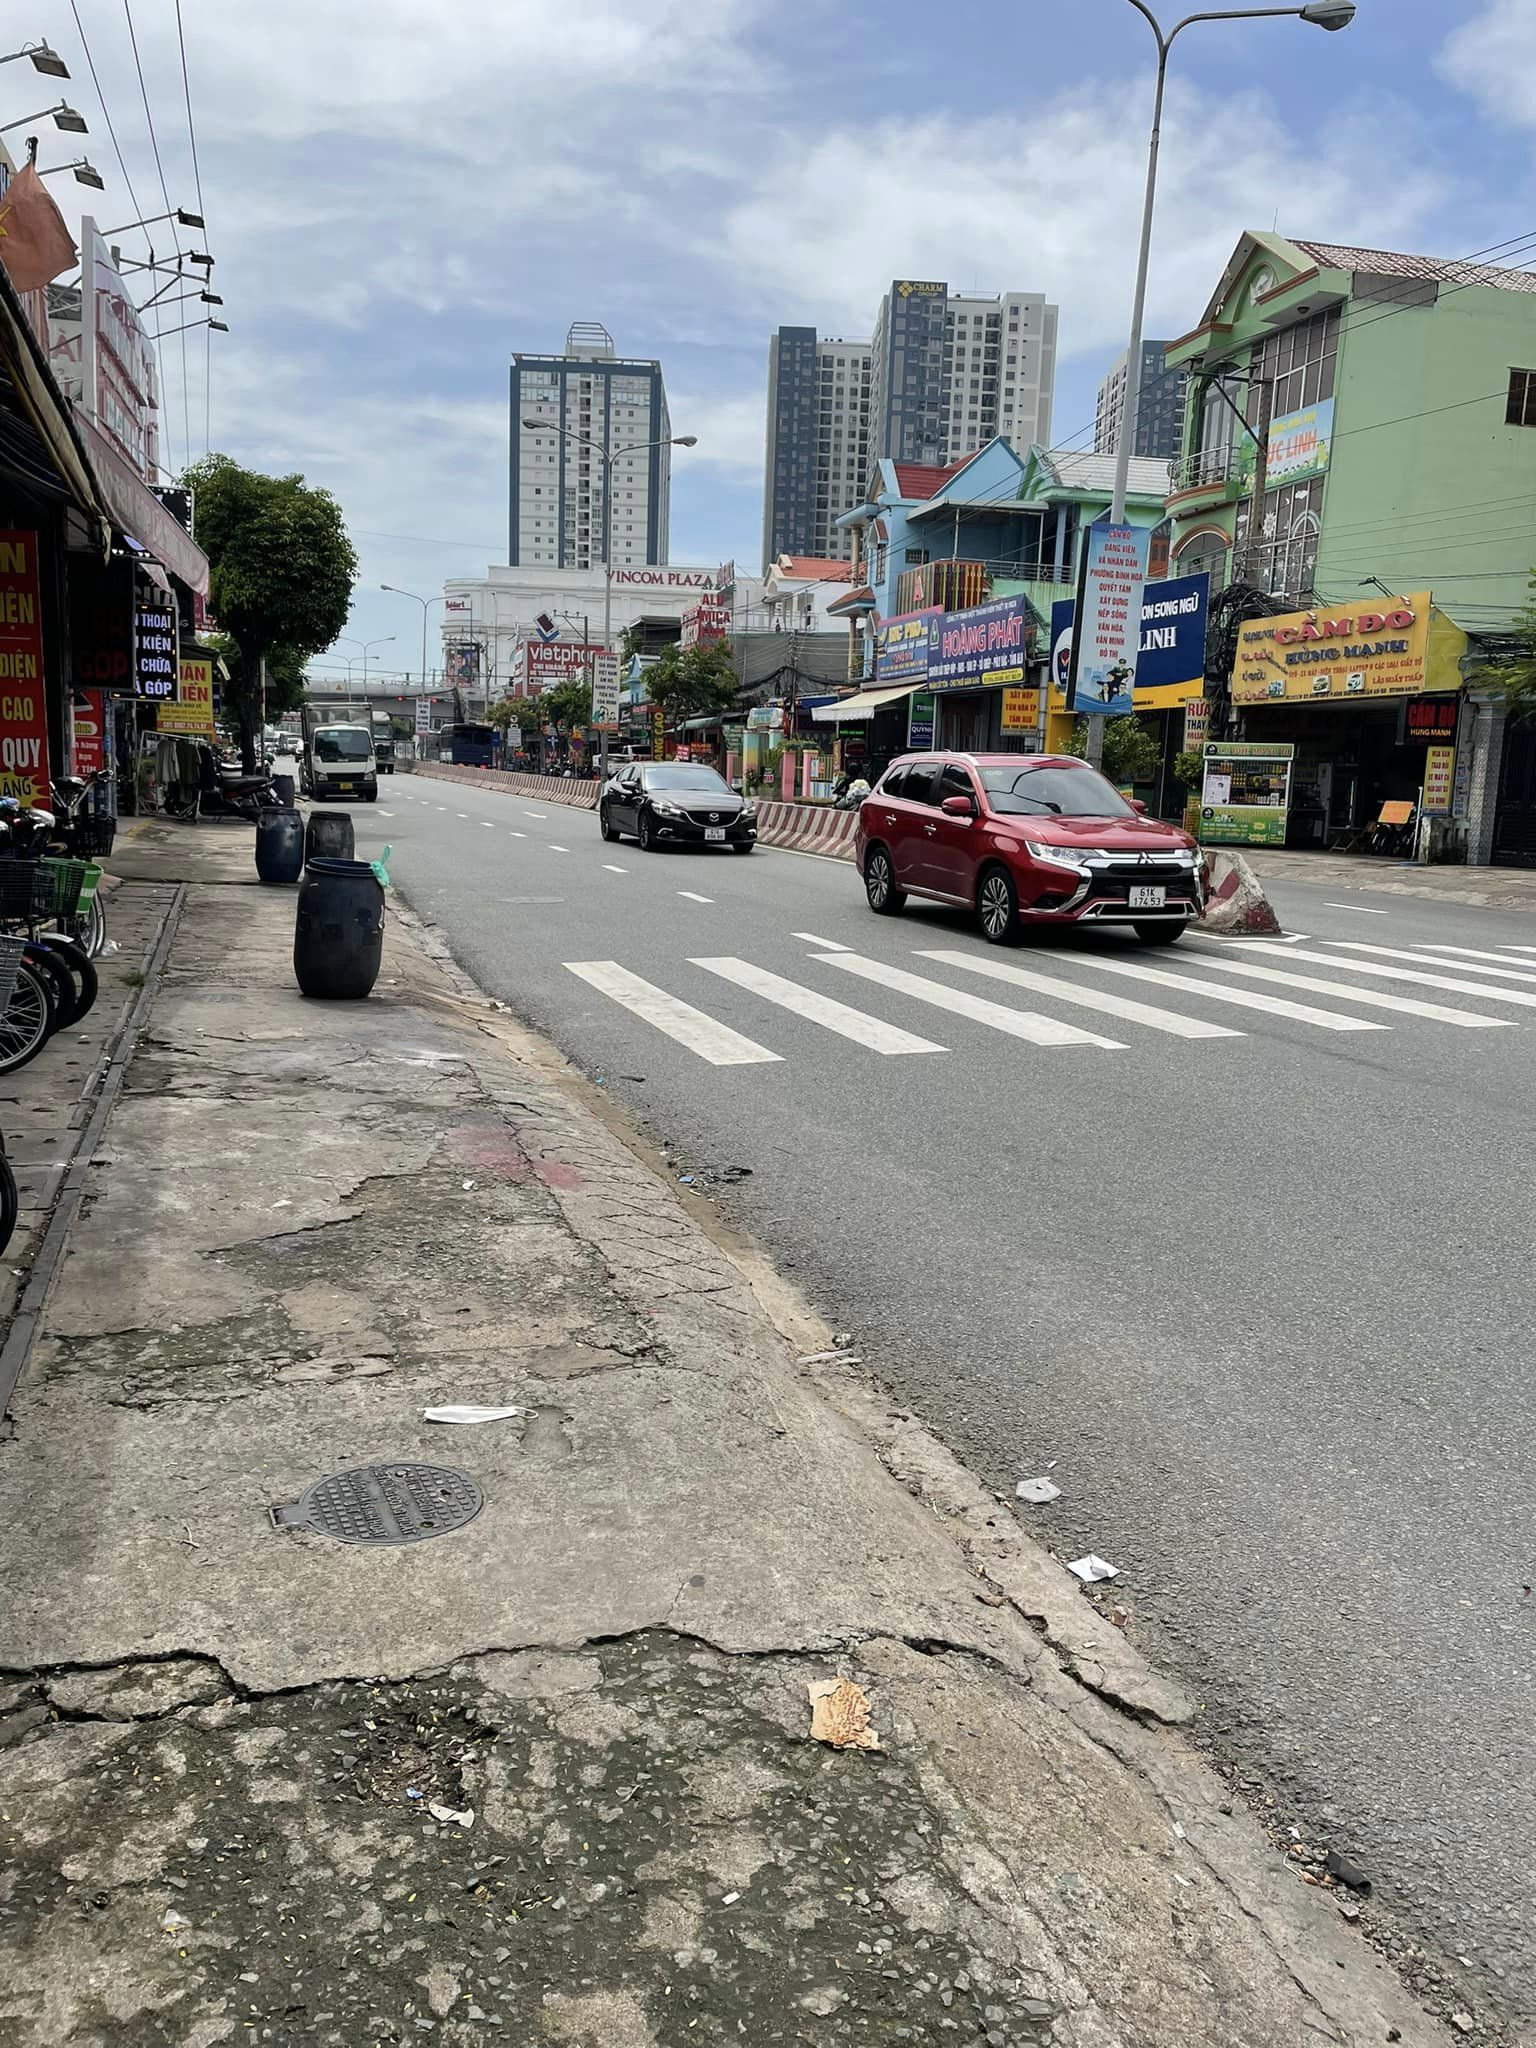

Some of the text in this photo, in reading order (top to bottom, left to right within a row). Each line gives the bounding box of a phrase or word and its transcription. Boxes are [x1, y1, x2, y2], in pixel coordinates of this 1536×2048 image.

[913, 283, 944, 292] CHARM
[604, 569, 713, 587] VINCOM PLAZA
[1154, 600, 1178, 617] SONG
[141, 613, 171, 631] THOẠI
[1274, 595, 1416, 645] CẦM ĐỒ
[142, 634, 171, 653] KIỆN
[943, 622, 986, 658] HOÀNG
[1286, 645, 1341, 665] HÙNG
[1343, 639, 1408, 660] MẠNH
[141, 656, 172, 673] CHỮA
[145, 679, 172, 695] GÓP
[3, 697, 34, 721] CAO
[1187, 719, 1206, 730] THAY
[2, 737, 41, 770] QUY
[1140, 887, 1155, 897] 61K
